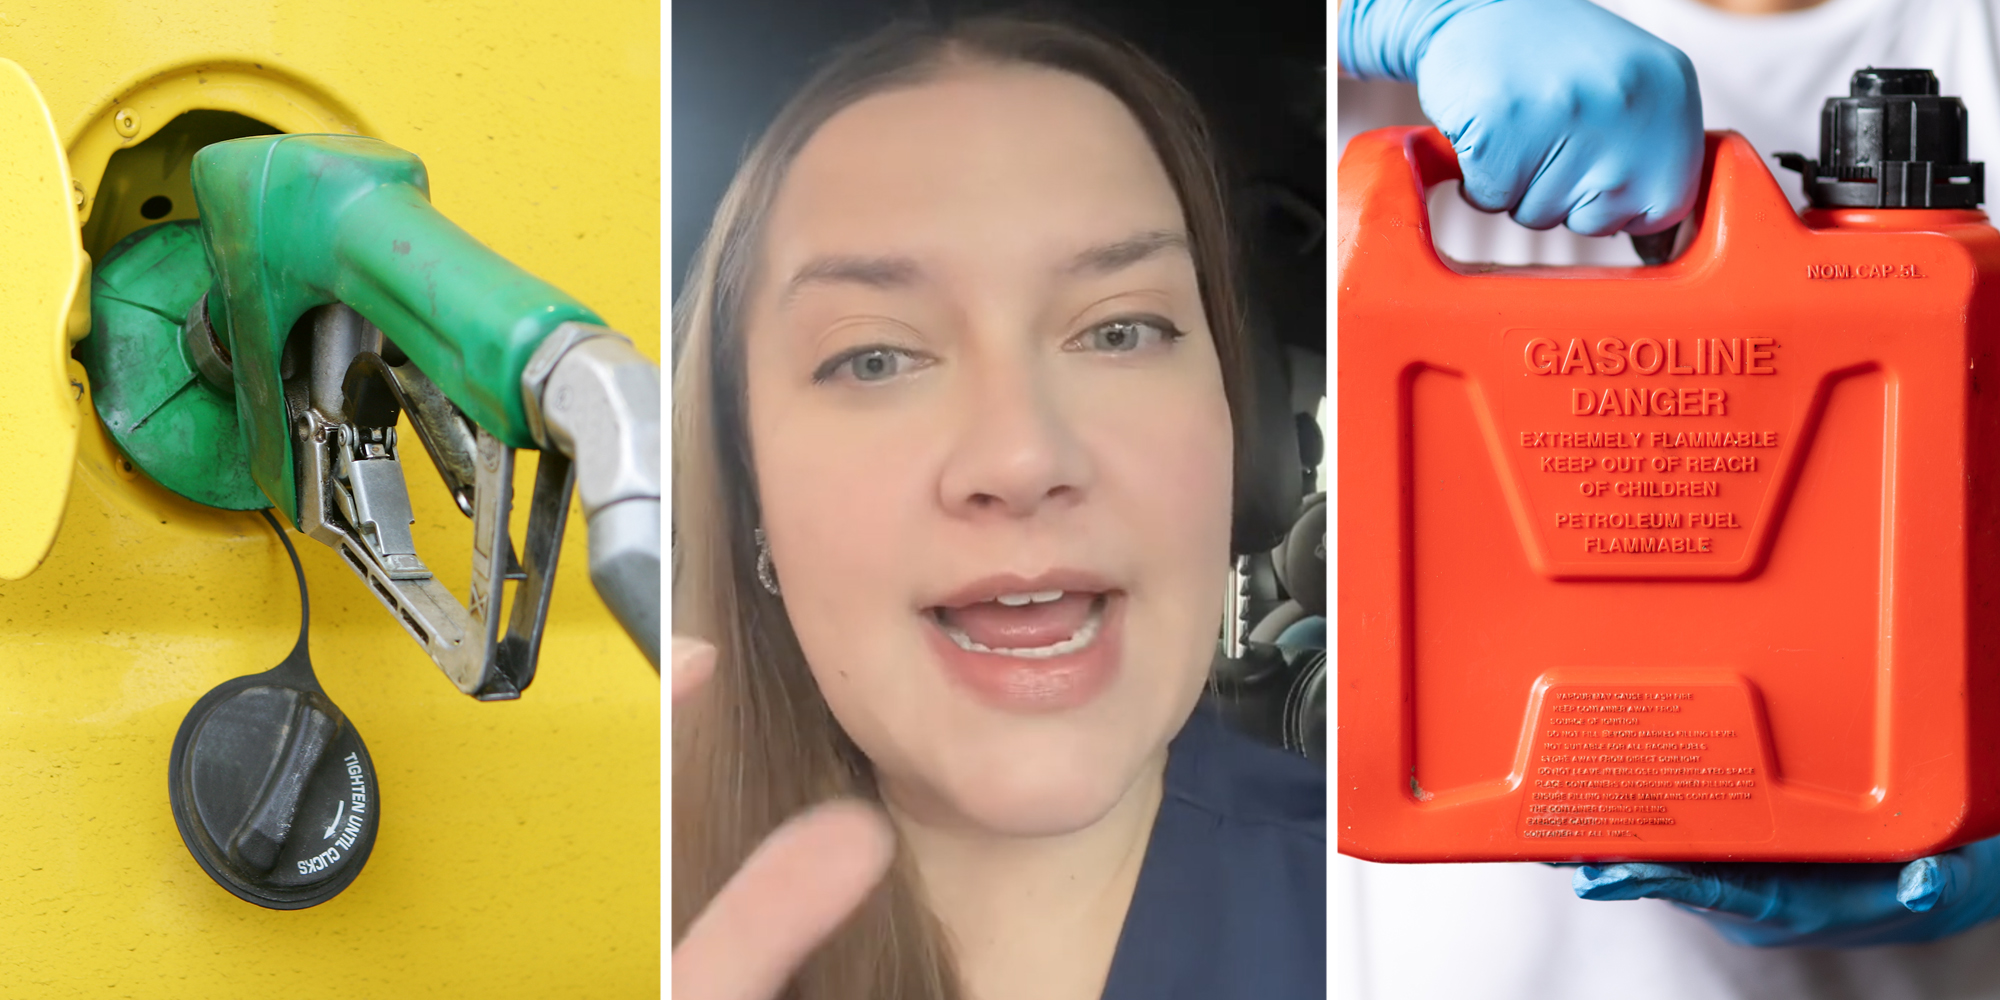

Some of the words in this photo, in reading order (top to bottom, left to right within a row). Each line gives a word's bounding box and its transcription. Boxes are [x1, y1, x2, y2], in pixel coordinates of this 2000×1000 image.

[1524, 337, 1775, 375] GASOLINE
[1572, 387, 1727, 416] DANGER
[1520, 432, 1643, 448] EXTREMELY
[1650, 432, 1777, 448] FLAMMABLE
[1540, 456, 1594, 472] KEEP
[1601, 456, 1644, 472] OUT
[1651, 456, 1680, 472] OF
[1686, 456, 1757, 472] REACH
[1579, 481, 1608, 497] OF
[1614, 481, 1719, 497] CHILDREN
[1555, 512, 1682, 529] PETROLEUM
[1688, 512, 1740, 529] FUEL
[1584, 537, 1711, 553] FLAMMABLE
[1556, 692, 1592, 701] VAPOUR
[1592, 692, 1612, 701] MAY
[1614, 692, 1643, 701] CAUSE
[1645, 692, 1672, 701] FLASH
[1674, 692, 1694, 701] FIRE
[1553, 705, 1576, 713] KEEP
[1577, 705, 1626, 713] CONTAINER
[1627, 705, 1654, 713] AWAY
[1656, 705, 1681, 713] FROM
[1550, 717, 1585, 726] SOURCE
[1588, 717, 1599, 726] OF
[1601, 717, 1639, 726] IGNITION
[1547, 730, 1560, 738] DO
[1562, 730, 1579, 738] NOT
[1582, 730, 1600, 738] FILL
[1602, 730, 1637, 738] BEYOND
[1639, 730, 1674, 738] MARKED
[1676, 730, 1709, 738] FILLING
[1711, 730, 1737, 738] LEVEL
[1544, 742, 1562, 751] NOT
[1564, 742, 1606, 751] SUITABLE
[1608, 742, 1625, 751] FOR
[1627, 742, 1643, 751] ALL
[1645, 742, 1678, 751] RACING
[1680, 742, 1707, 751] FUELS
[1541, 755, 1570, 763] STORE
[1571, 755, 1597, 763] AWAY
[1599, 755, 1624, 763] FROM
[1626, 755, 1657, 763] DIRECT
[1659, 755, 1701, 763] SUNLIGHT
[1538, 767, 1551, 776] DO
[1552, 767, 1571, 776] NOT
[1573, 767, 1600, 776] LEAVE
[1602, 767, 1612, 776] IN
[1613, 767, 1659, 776] ENCLOSED
[1661, 767, 1724, 776] UNVENTILATED
[1726, 767, 1755, 776] SPACE
[344, 751, 366, 813] TIGHTEN
[1535, 780, 1563, 788] PLACE
[1565, 780, 1619, 788] CONTAINERS
[1621, 780, 1635, 788] ON
[1636, 780, 1673, 788] GROUND
[1674, 780, 1700, 788] WHEN
[1702, 780, 1735, 788] FILLING
[1736, 780, 1755, 788] AND
[1532, 792, 1566, 801] ENSURE
[1568, 792, 1601, 801] FILLING
[1602, 792, 1636, 801] NOZZLE
[1637, 792, 1684, 801] MAINTAINS
[1686, 792, 1727, 801] CONTACT
[1728, 792, 1752, 801] WITH
[1529, 804, 1547, 813] THE
[1548, 804, 1598, 813] CONTAINER
[1599, 804, 1632, 813] DURING
[1633, 804, 1667, 813] FILLING
[1526, 817, 1568, 826] EXERCISE
[1569, 817, 1607, 826] CAUTION
[1608, 817, 1635, 826] WHEN
[1636, 817, 1676, 826] OPENING
[334, 814, 363, 851] UNTIL
[1523, 830, 1572, 839] CONTAINER
[1574, 830, 1586, 839] AT
[1587, 830, 1603, 839] ALL
[1607, 830, 1632, 839] TIMES
[297, 846, 340, 875] CLICKS
